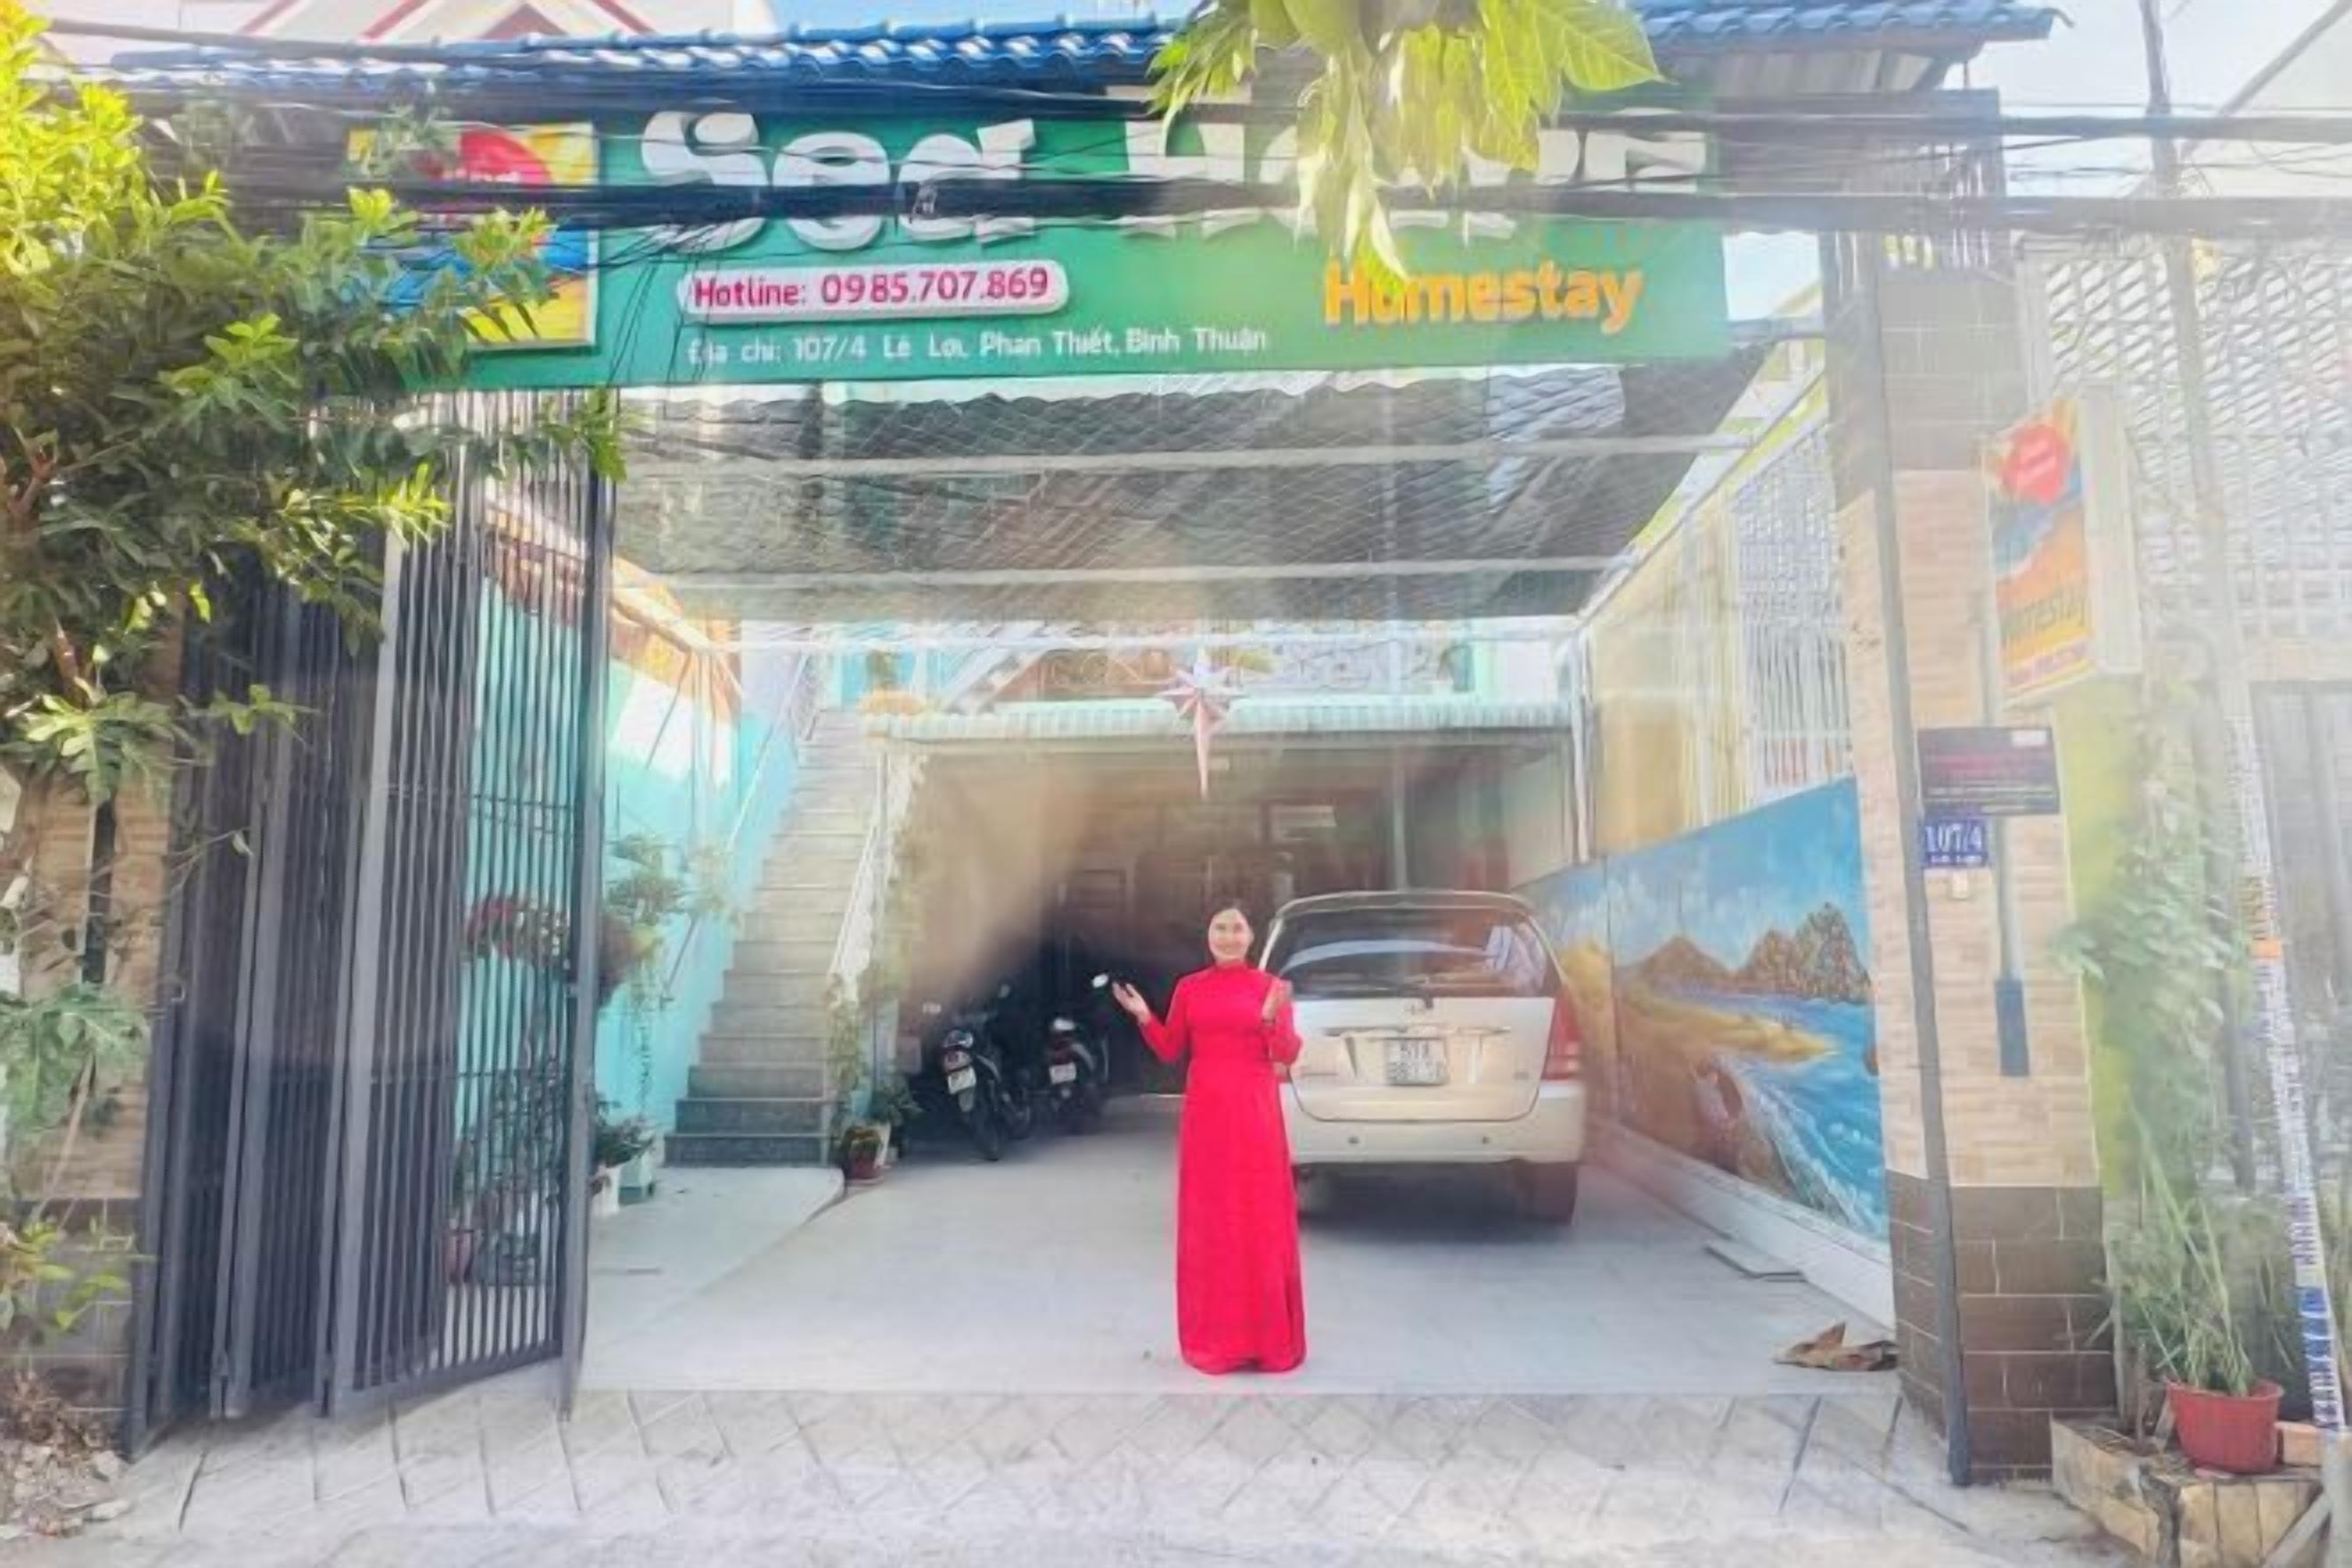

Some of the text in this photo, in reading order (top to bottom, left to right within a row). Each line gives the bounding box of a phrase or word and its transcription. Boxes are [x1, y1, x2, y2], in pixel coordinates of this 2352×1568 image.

[693, 265, 1049, 308] Hotline: 0985.707.869
[1324, 257, 1646, 335] Homestay
[792, 335, 867, 362] 107/4
[979, 330, 1041, 356] Phan
